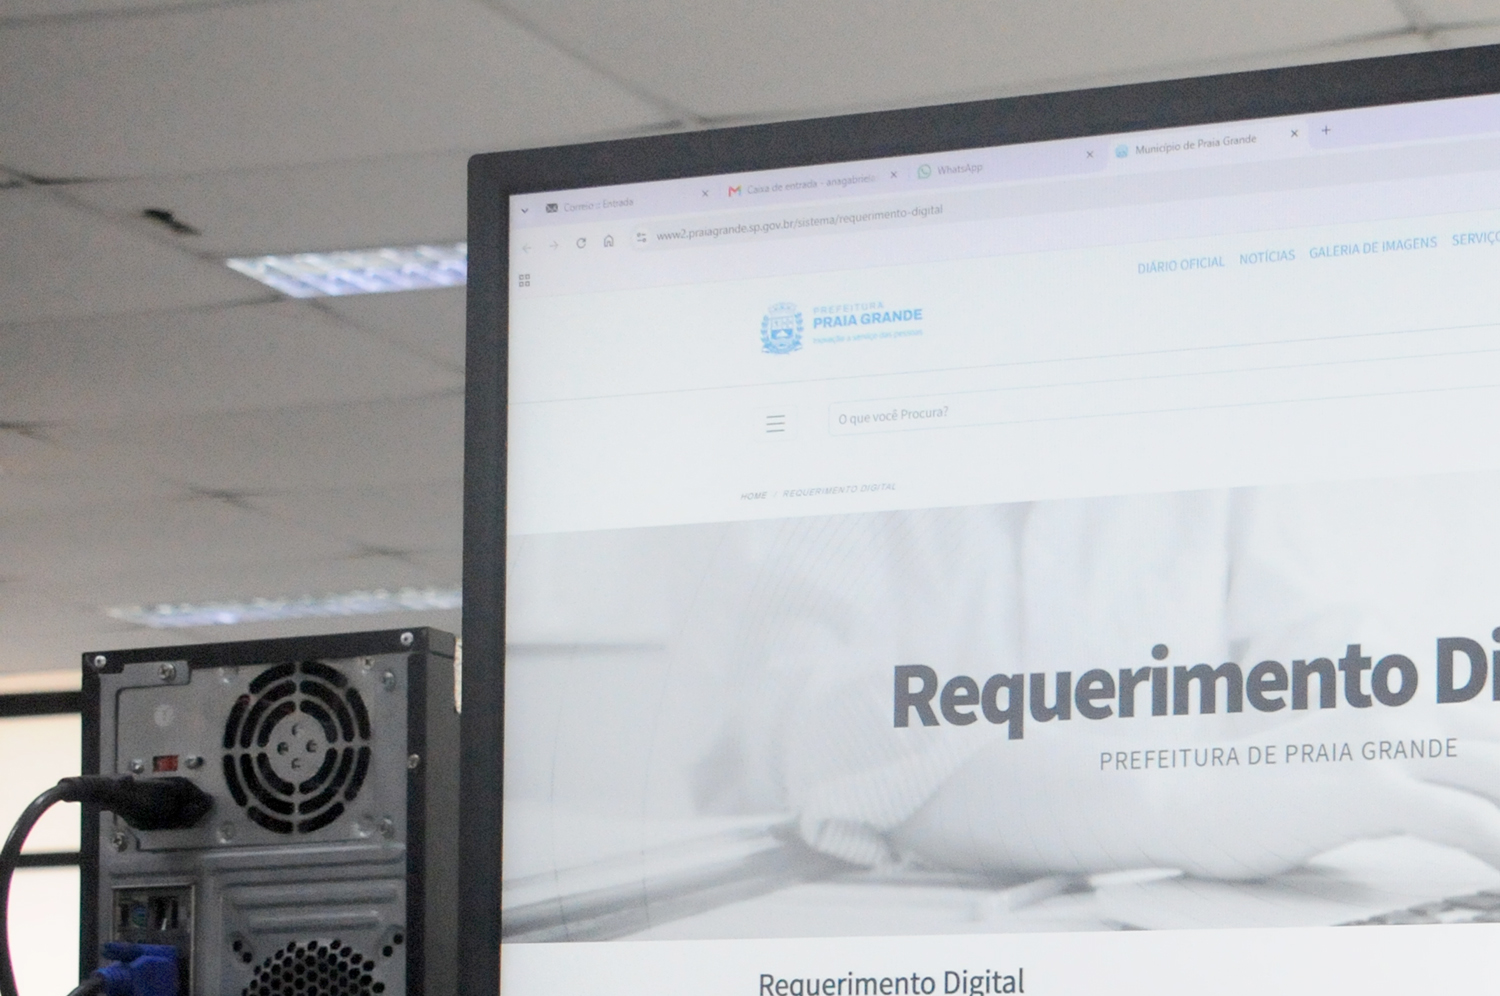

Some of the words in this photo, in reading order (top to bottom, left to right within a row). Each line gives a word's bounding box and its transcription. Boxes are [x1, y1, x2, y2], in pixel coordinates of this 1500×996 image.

[1135, 140, 1180, 154] Município
[1183, 140, 1195, 150] de
[1197, 138, 1220, 149] Praia
[1223, 135, 1257, 146] Grande
[937, 163, 983, 175] WhatsApp
[747, 184, 771, 195] Caixa
[774, 182, 783, 192] de
[785, 180, 818, 191] entrada
[564, 203, 594, 213] Correio
[602, 198, 634, 209] Entrada
[656, 204, 944, 241] www2.praiagrande.sp.gov.br/sistema/requerimento-digital
[1240, 248, 1296, 266] NOTÍCIAS
[1309, 243, 1360, 260] GALERIA
[1362, 241, 1379, 255] DE
[1382, 236, 1438, 252] IMAGENS
[1137, 258, 1178, 275] DIÁRIO
[1180, 255, 1225, 271] OFICIAL
[813, 302, 884, 315] PREFEITURA
[813, 313, 858, 329] PRAIA
[860, 308, 923, 325] GRANDE
[838, 414, 847, 425] O
[849, 412, 871, 426] que
[873, 409, 898, 422] você
[900, 406, 949, 420] Procura?
[892, 643, 1420, 741] Requerimento
[1099, 746, 1241, 771] PREFEITURA
[1247, 745, 1278, 766] DE
[1285, 741, 1355, 765] PRAIA
[1361, 737, 1459, 761] GRANDE
